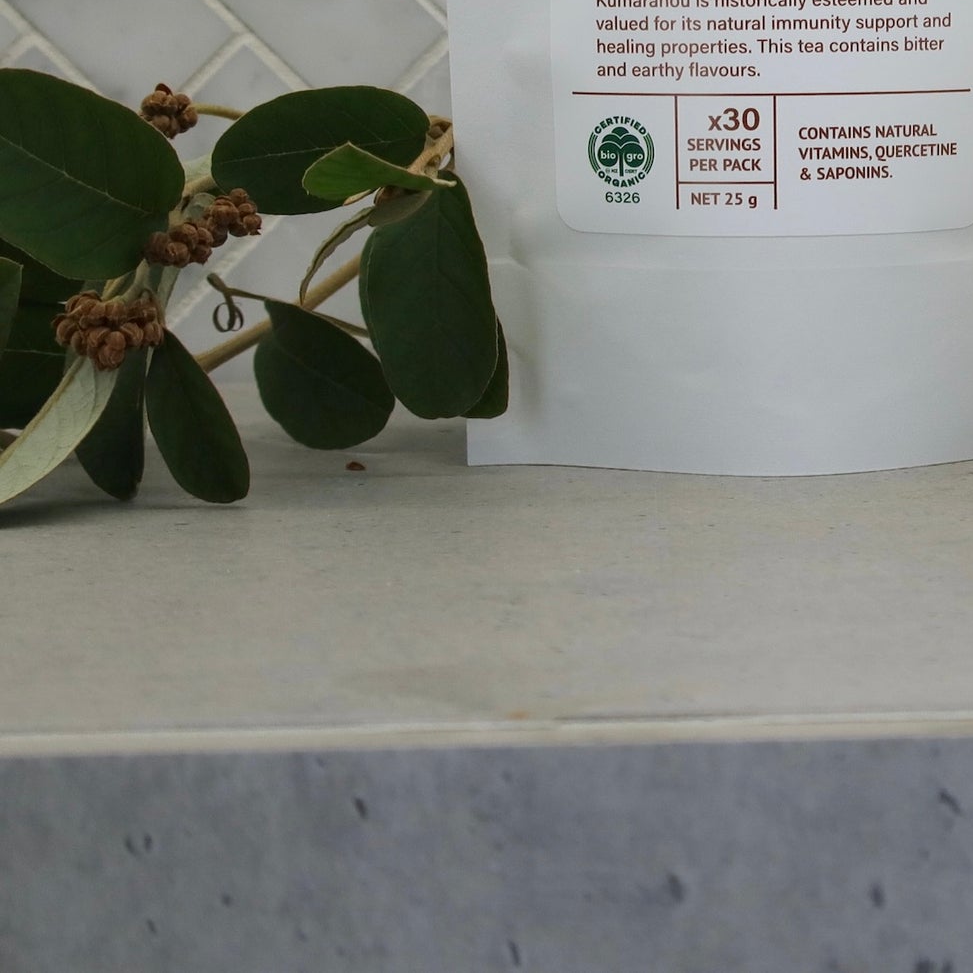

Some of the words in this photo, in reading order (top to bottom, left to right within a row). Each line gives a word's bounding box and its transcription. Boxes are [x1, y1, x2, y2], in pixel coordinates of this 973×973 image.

[595, 15, 649, 31] valued
[653, 15, 677, 31] for
[681, 15, 702, 31] its
[707, 15, 766, 31] natural
[771, 14, 851, 34] immunity
[855, 14, 919, 33] support
[922, 12, 952, 28] and
[596, 38, 655, 58] healing
[661, 38, 752, 58] properties.
[756, 38, 793, 54] This
[797, 39, 824, 53] tea
[829, 36, 899, 53] contains
[904, 36, 945, 52] bitter
[597, 61, 627, 77] and
[631, 61, 684, 81] earthy
[688, 61, 761, 77] flavours.
[594, 115, 647, 135] CERTIFIED
[708, 107, 760, 131] x30
[798, 125, 872, 140] CONTAINS
[875, 123, 938, 139] NATURAL
[687, 137, 761, 152] SERVINGS
[798, 145, 873, 161] VITAMINS,
[875, 142, 958, 162] QUERCETINE
[600, 150, 617, 160] bio
[626, 153, 644, 163] gro
[689, 158, 719, 172] PER
[723, 158, 762, 172] PACK
[597, 170, 646, 188] ORGANIC
[799, 167, 812, 181] &
[816, 165, 893, 181] SAPONINS.
[605, 191, 641, 204] 6326
[690, 192, 721, 206] NET
[724, 192, 743, 206] 25
[748, 195, 758, 209] g
